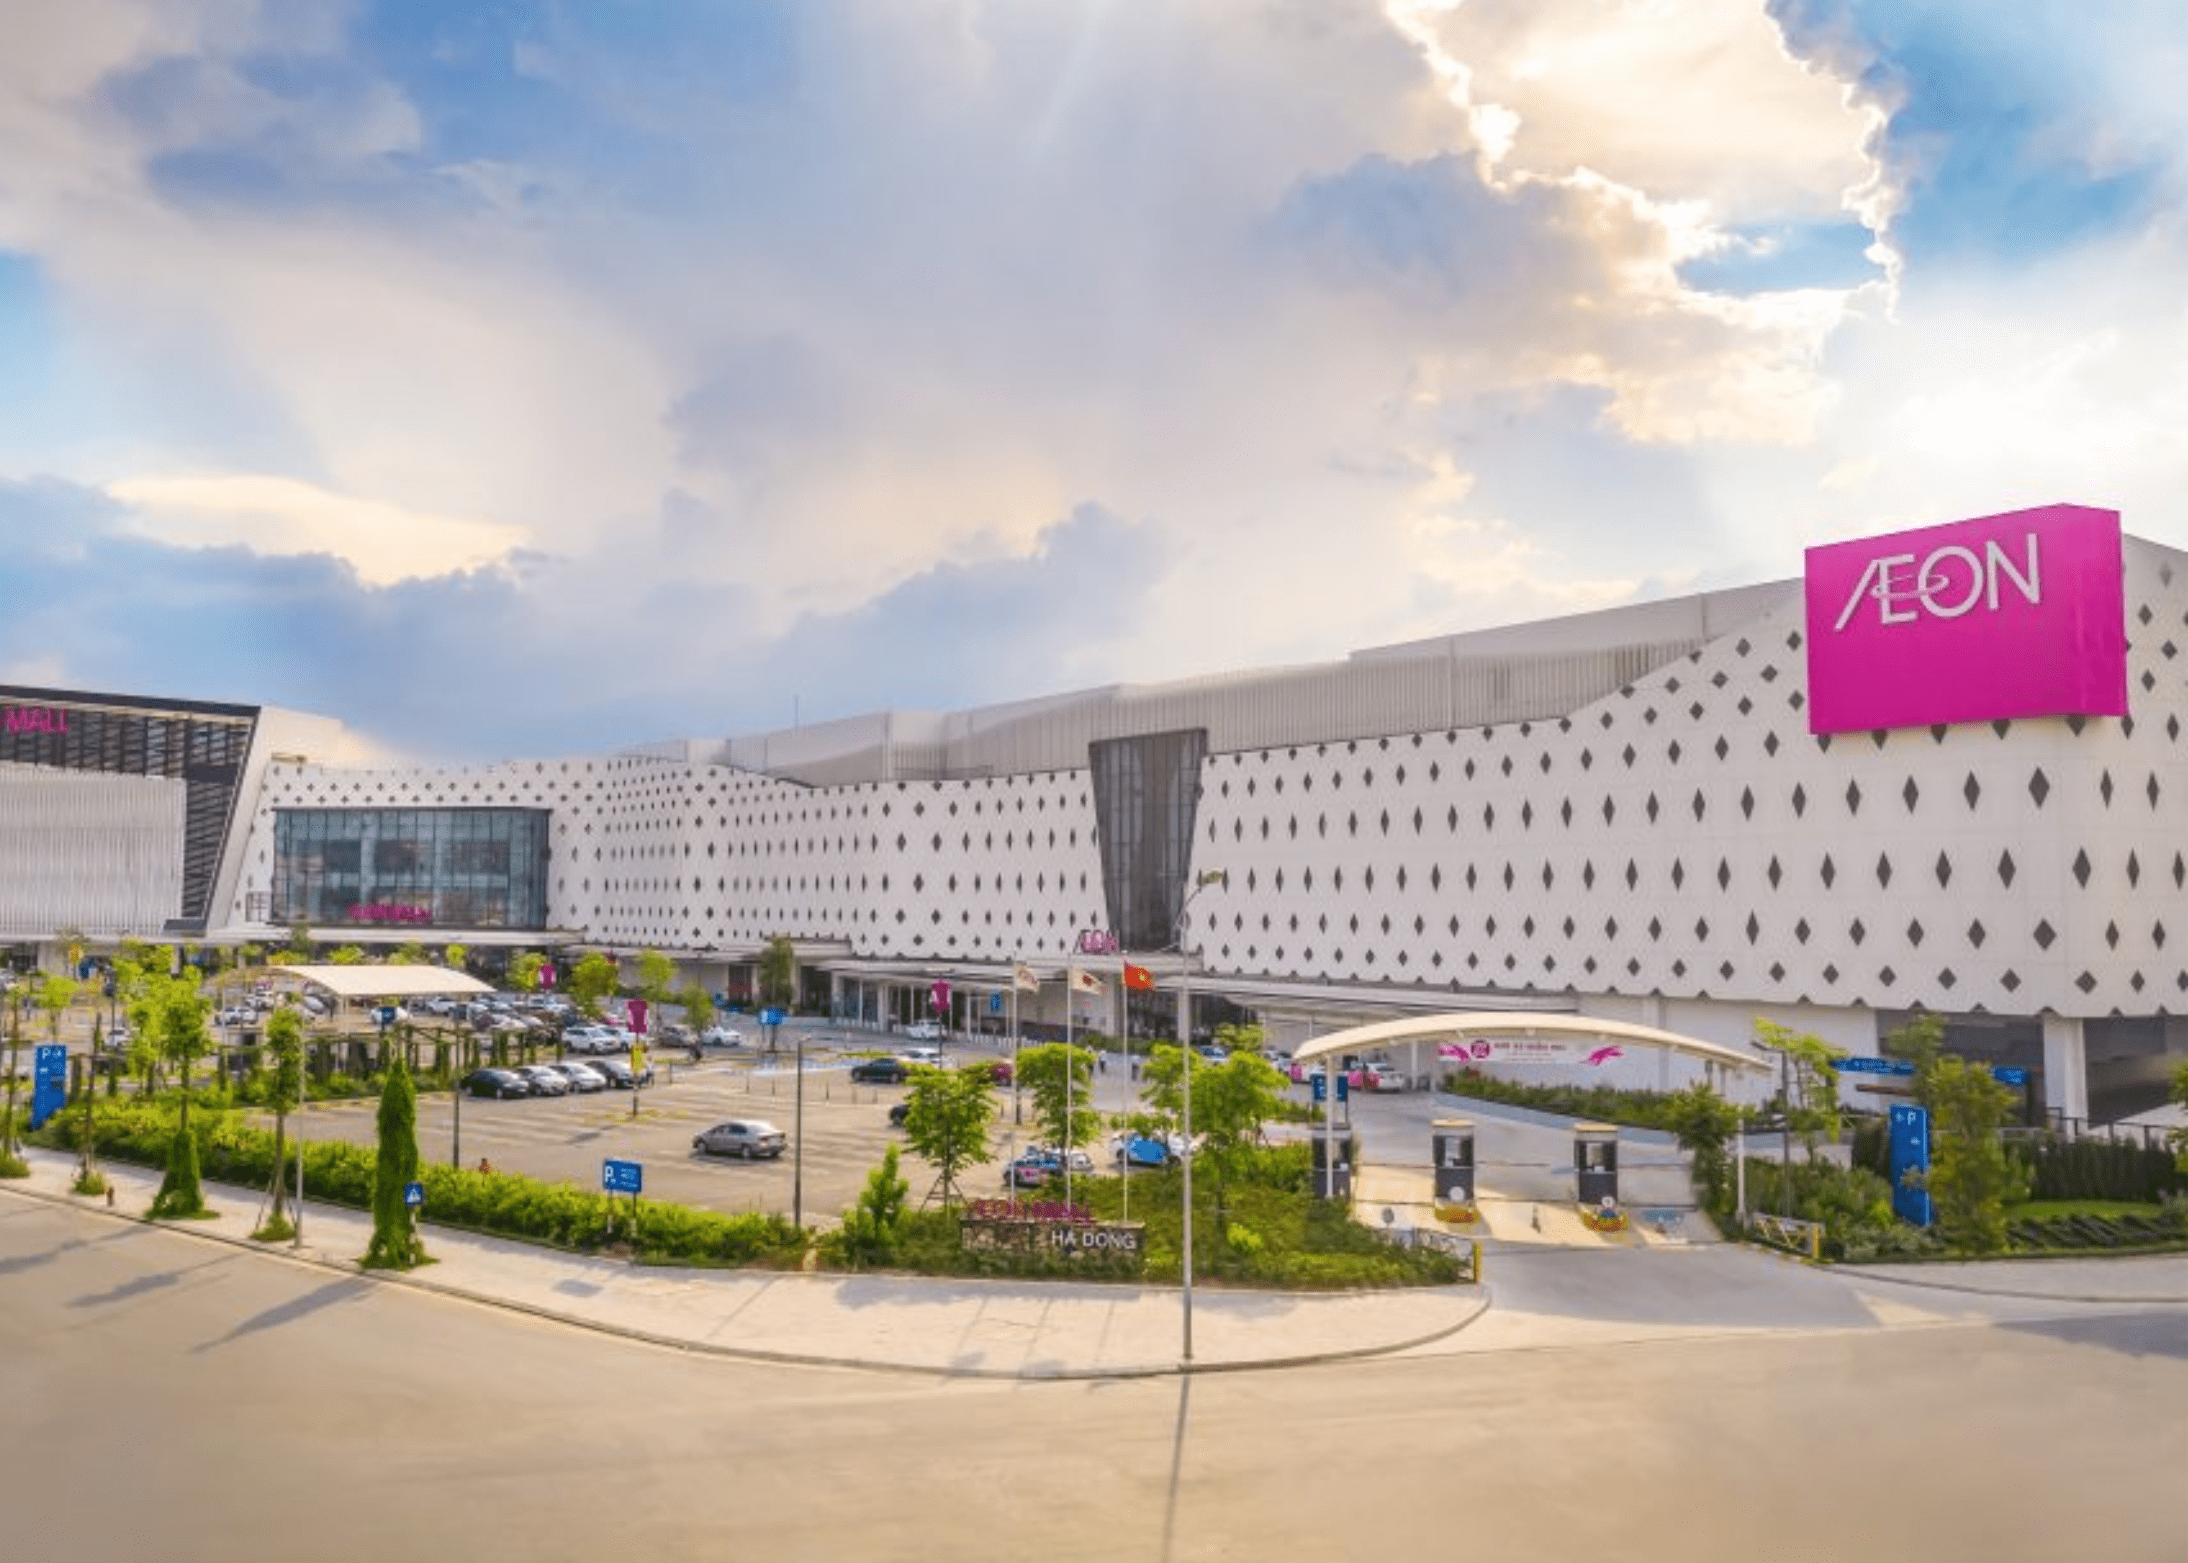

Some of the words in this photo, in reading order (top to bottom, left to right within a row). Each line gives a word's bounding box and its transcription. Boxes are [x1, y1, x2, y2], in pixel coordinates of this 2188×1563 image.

[5, 704, 70, 734] MALL
[605, 1165, 614, 1182] P
[1051, 1229, 1077, 1247] HA
[1082, 1231, 1138, 1250] DONG
